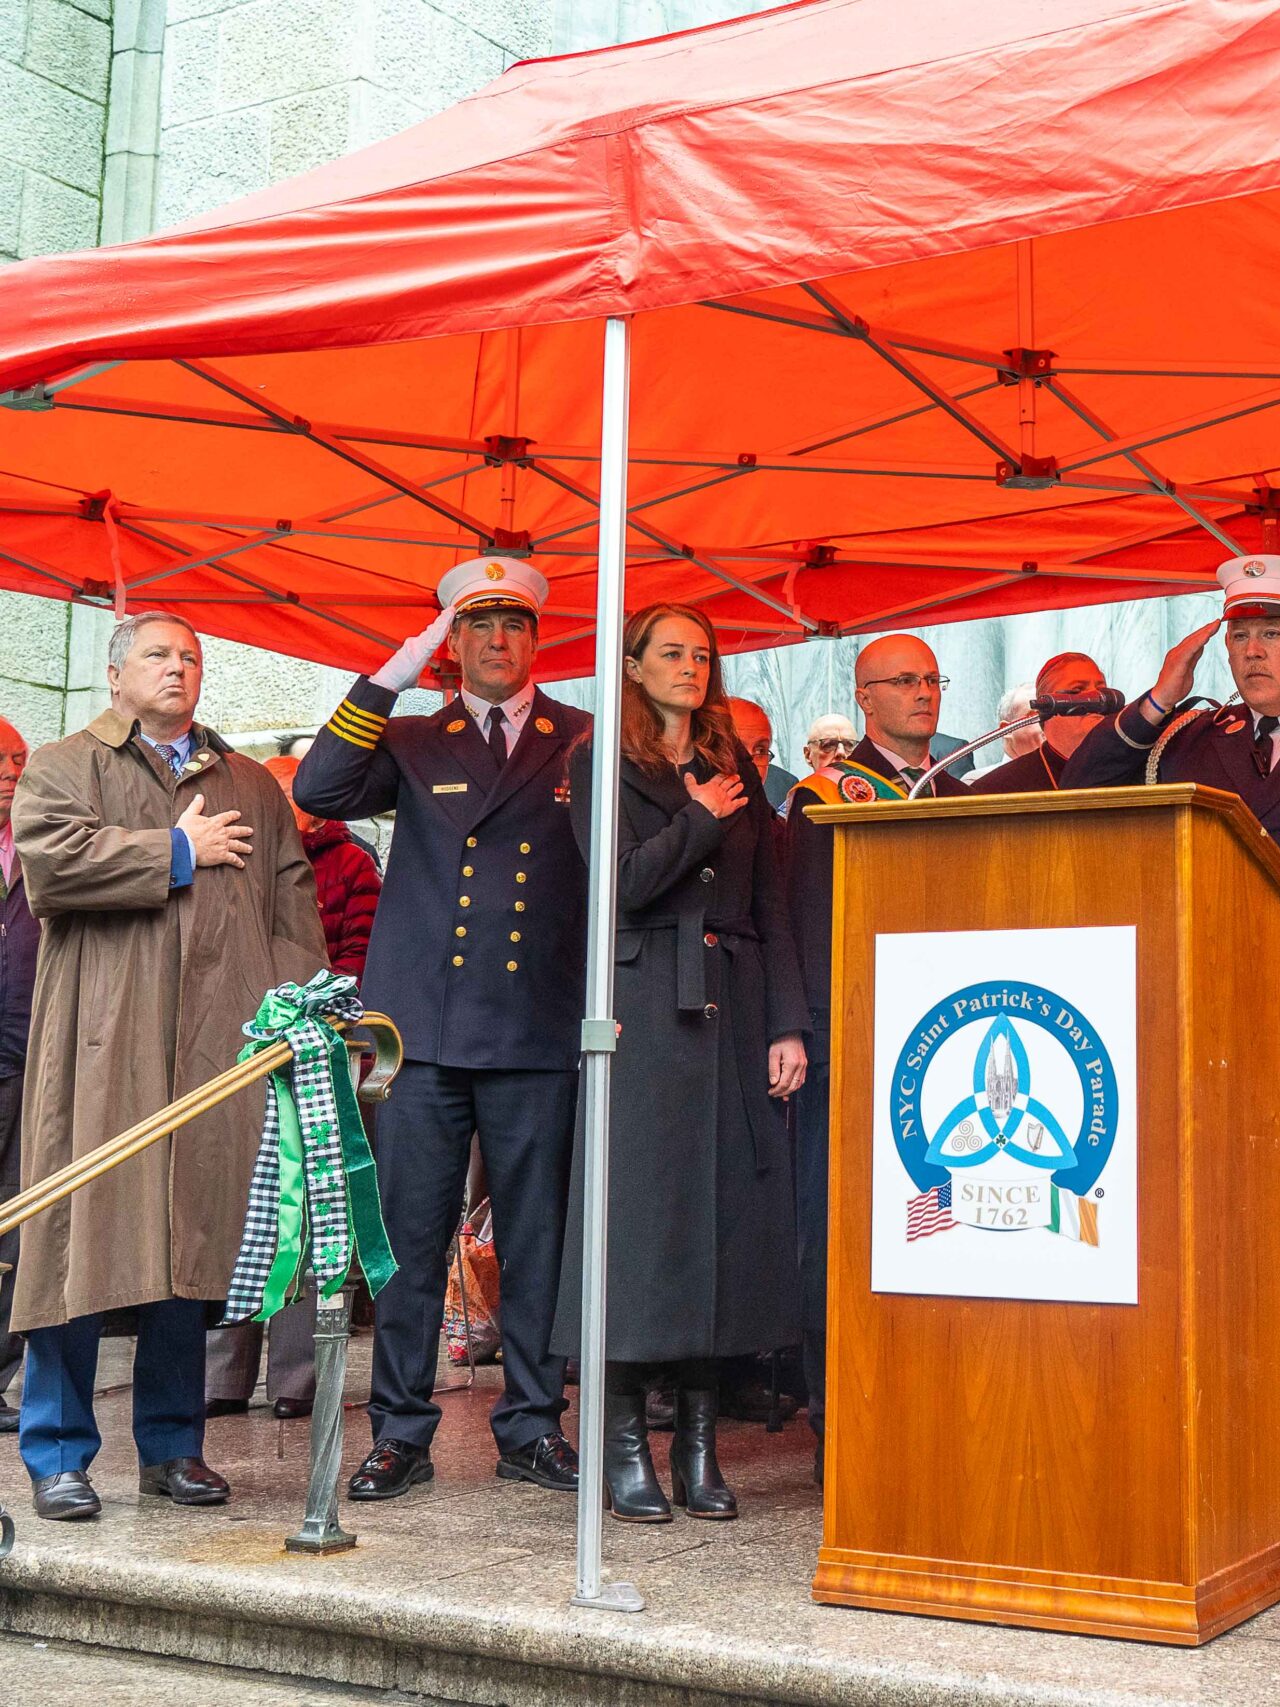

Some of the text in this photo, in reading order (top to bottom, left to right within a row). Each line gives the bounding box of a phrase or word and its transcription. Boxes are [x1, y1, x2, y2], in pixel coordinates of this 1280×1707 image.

[907, 1014, 950, 1070] Saint
[1055, 1008, 1093, 1051] Day
[899, 1075, 917, 1141] NYC
[1085, 1057, 1107, 1147] Parade
[961, 1183, 1041, 1205] SINCE
[976, 1207, 1029, 1226] 1762
